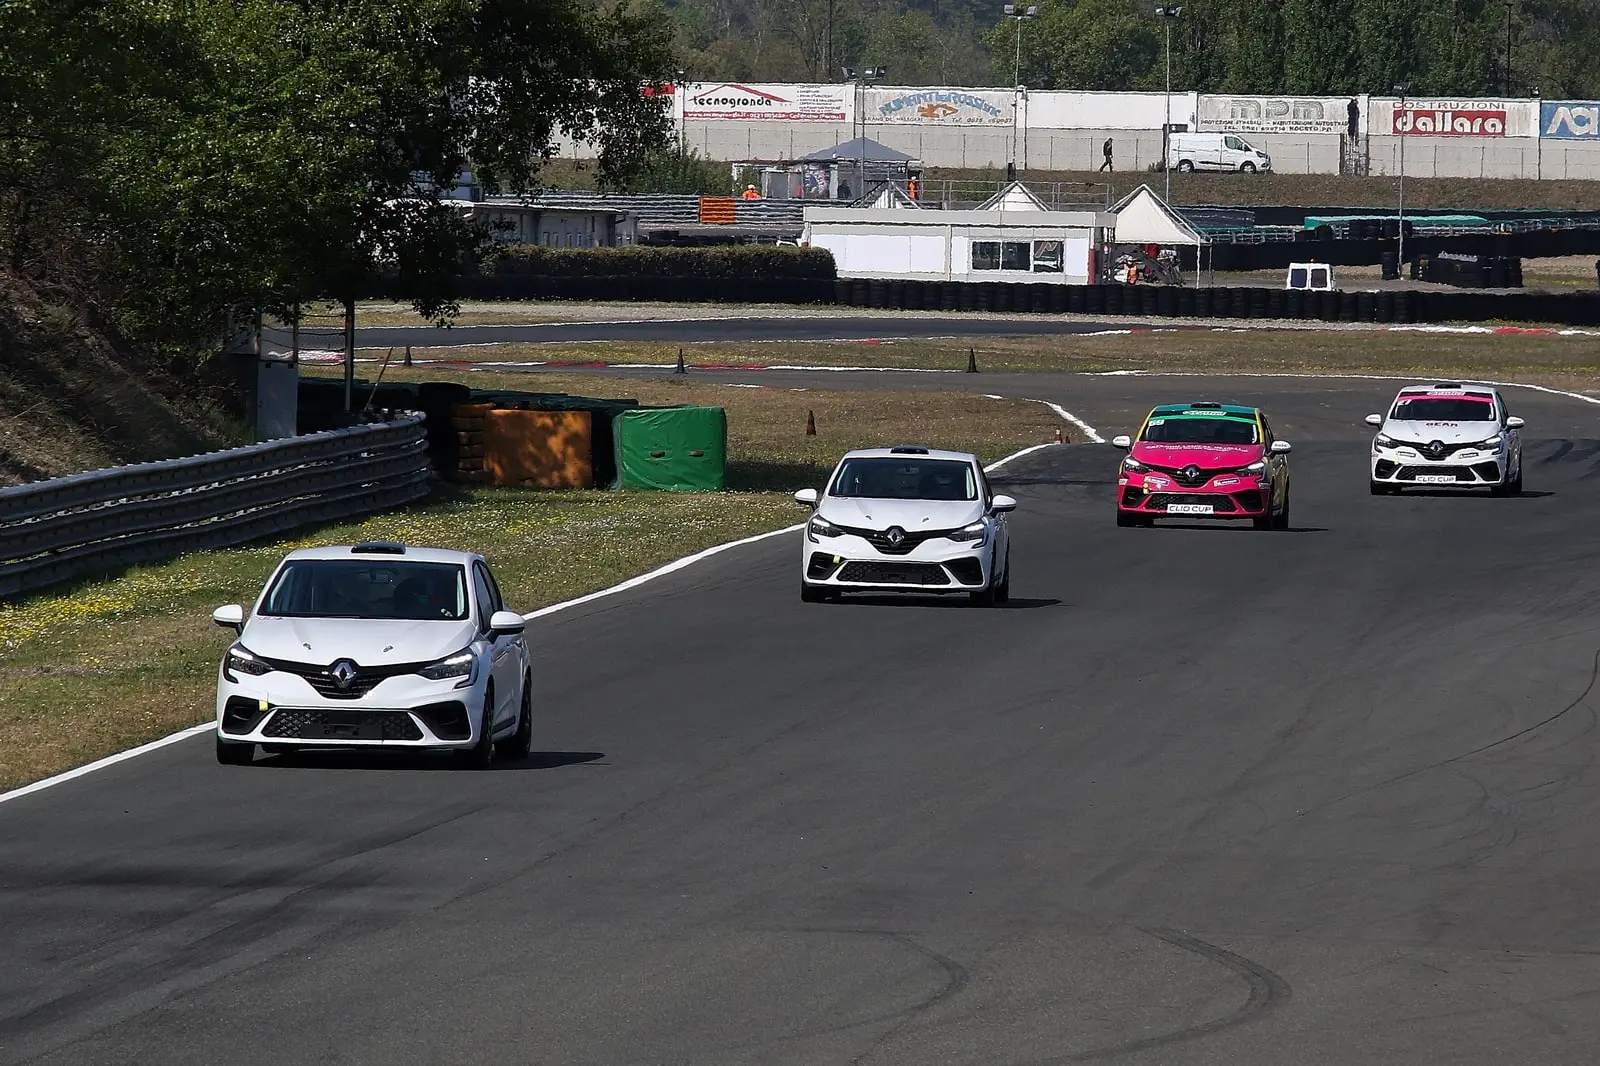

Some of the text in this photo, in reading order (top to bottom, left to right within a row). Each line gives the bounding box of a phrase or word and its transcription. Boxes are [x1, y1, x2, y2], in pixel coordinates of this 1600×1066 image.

[693, 95, 772, 109] tecnogronda
[1392, 101, 1505, 109] COSTRUZIONI
[1396, 110, 1503, 133] dallara
[1191, 505, 1212, 513] CUP
